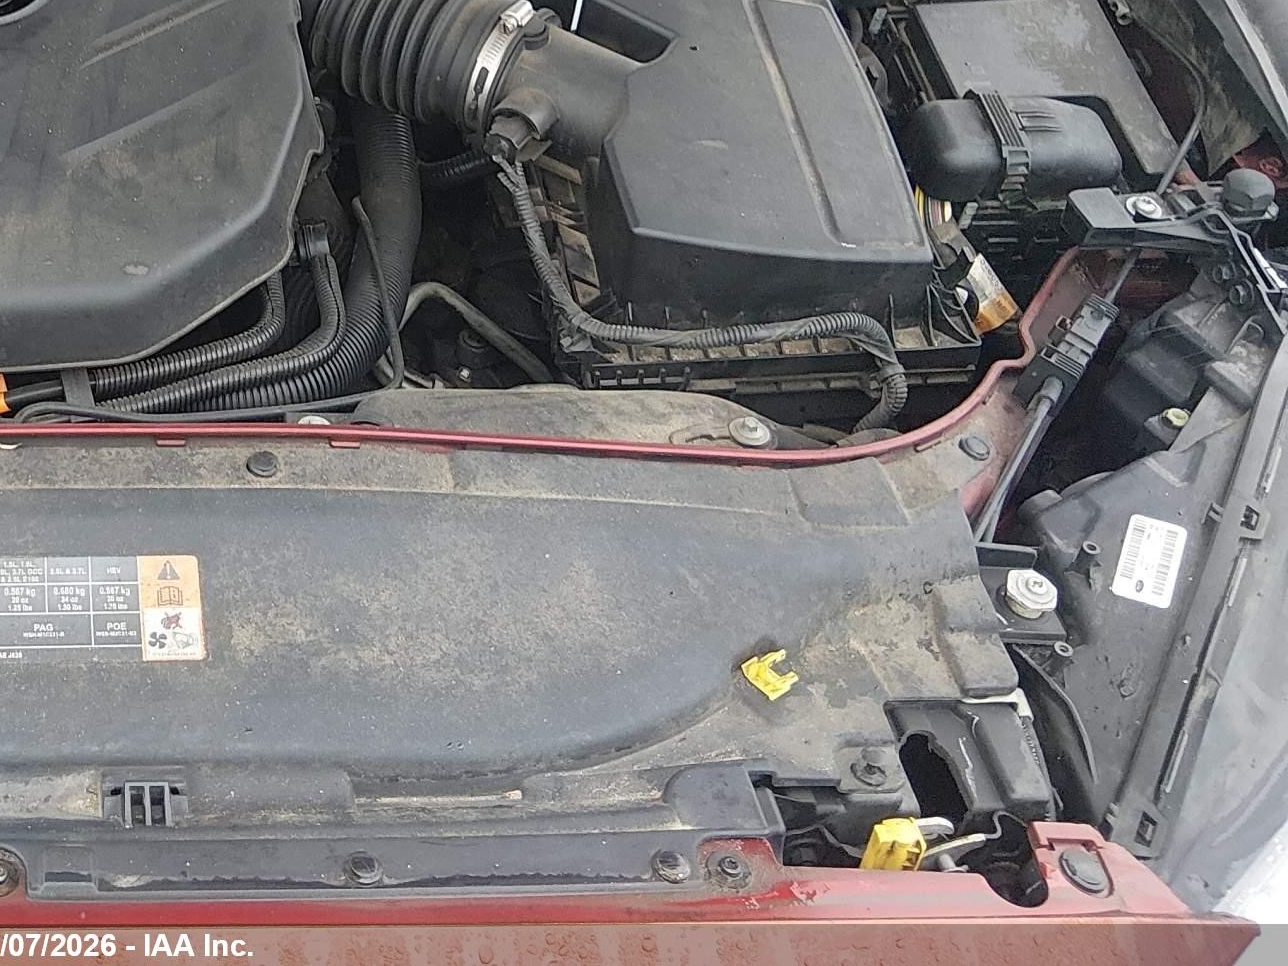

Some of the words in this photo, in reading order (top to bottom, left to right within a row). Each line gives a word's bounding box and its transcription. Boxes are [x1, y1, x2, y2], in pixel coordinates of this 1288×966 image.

[26, 587, 36, 597] kg
[75, 586, 85, 596] kg
[120, 586, 131, 596] kg
[33, 623, 54, 632] PAG
[106, 622, 127, 631] POE
